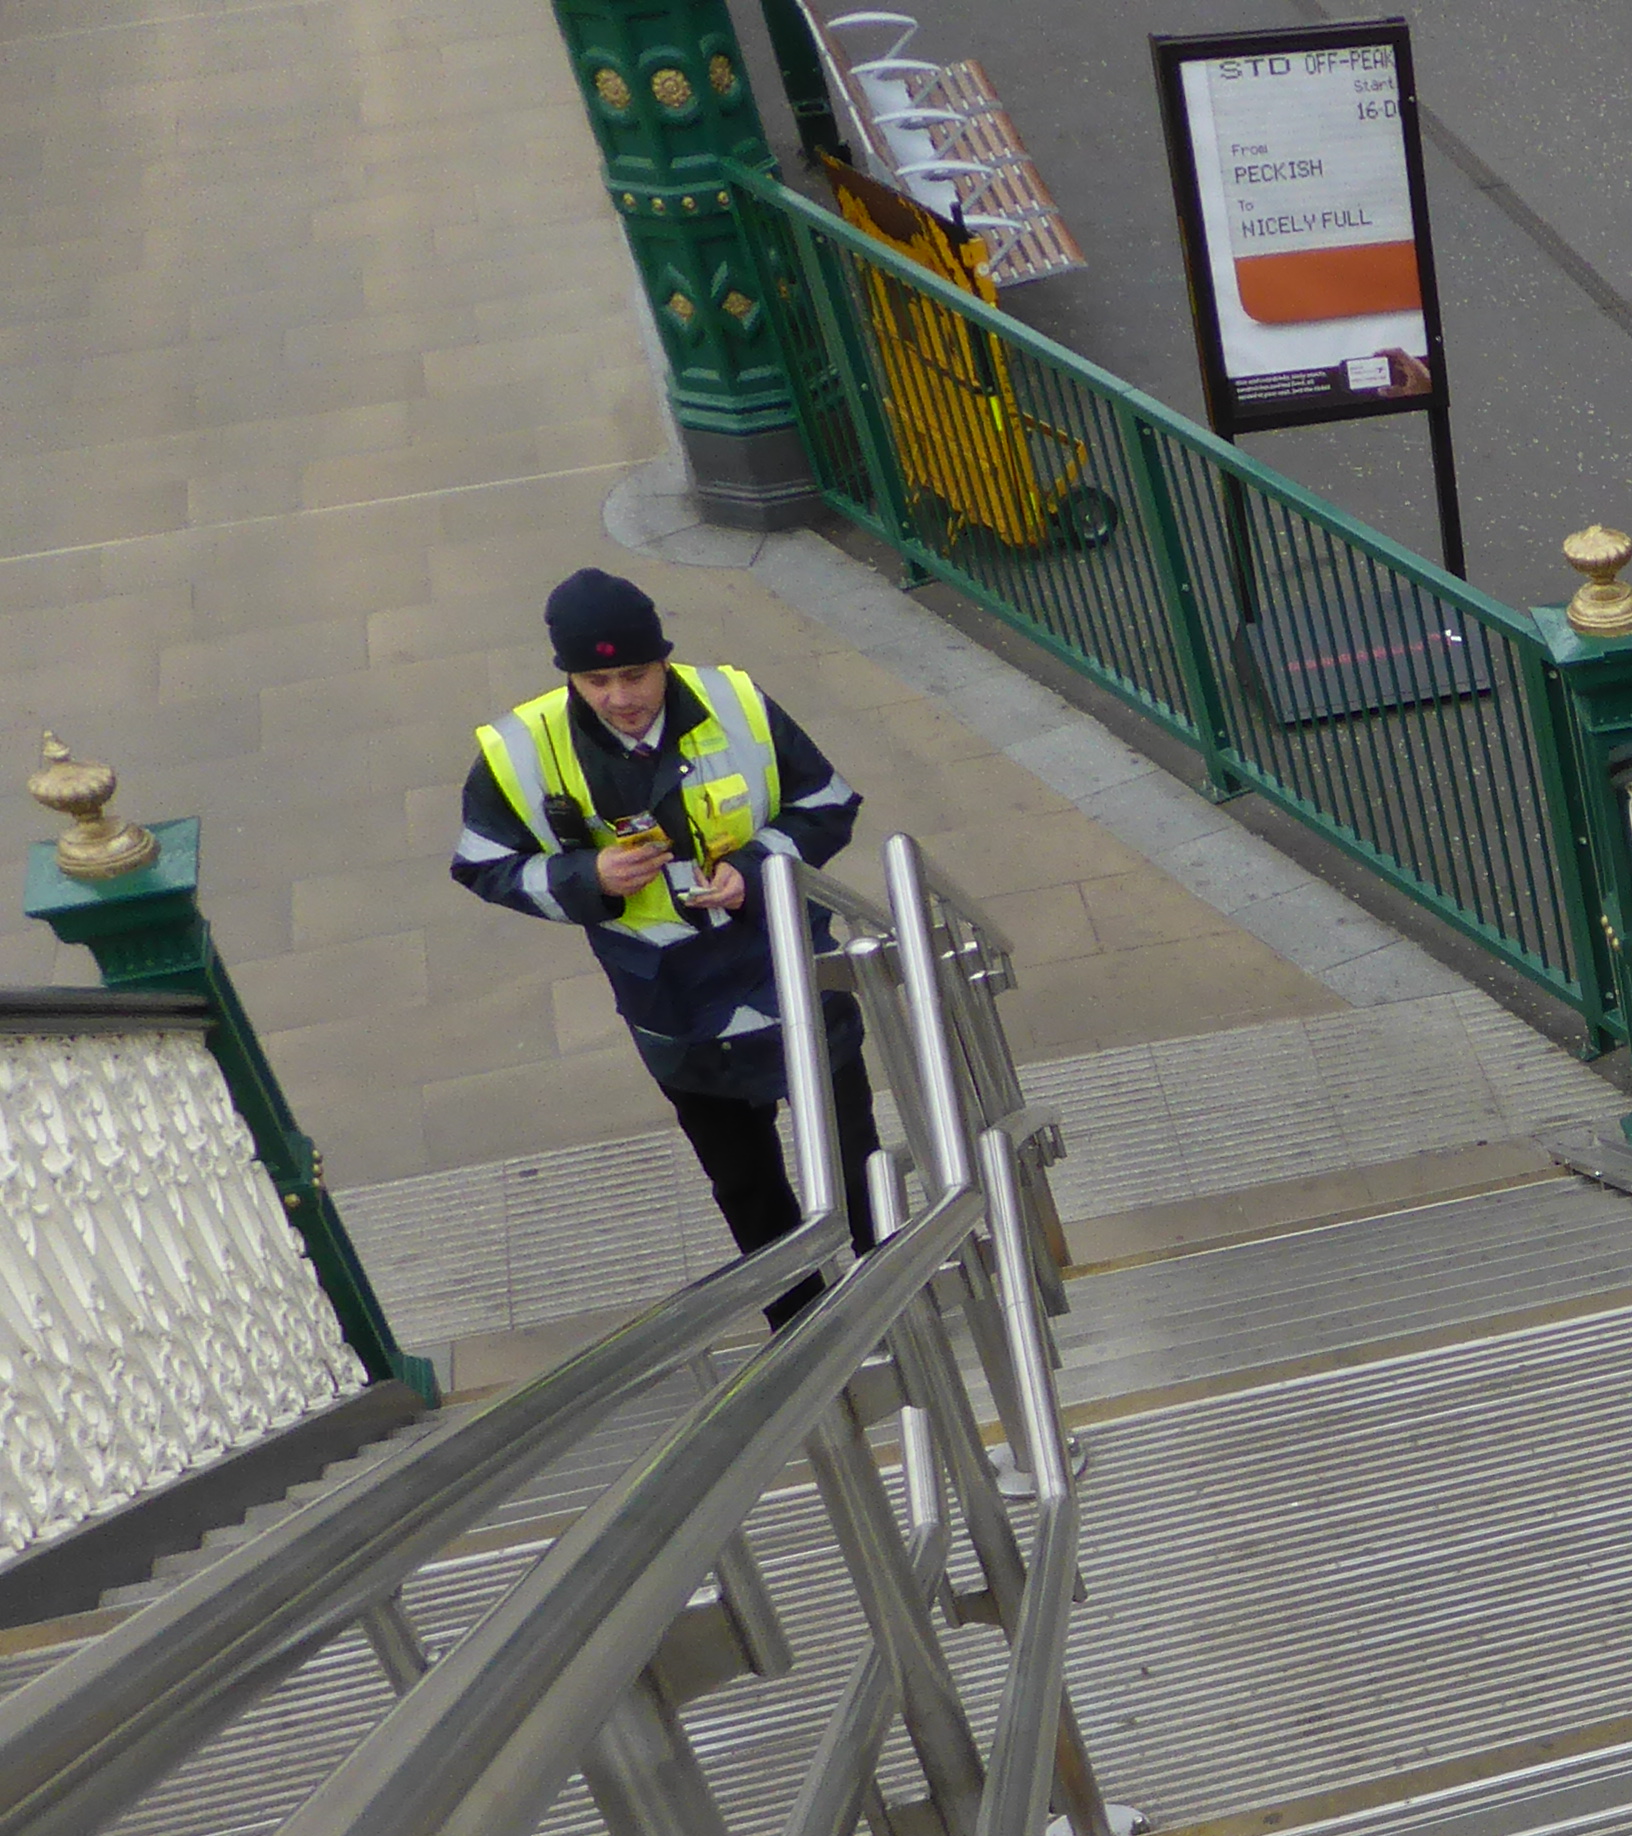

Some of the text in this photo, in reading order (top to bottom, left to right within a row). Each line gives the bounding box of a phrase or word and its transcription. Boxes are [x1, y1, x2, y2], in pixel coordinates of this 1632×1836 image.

[1219, 56, 1291, 80] STD
[1353, 77, 1395, 94] Start
[1356, 100, 1400, 121] 16-D
[1231, 143, 1269, 157] From
[1234, 159, 1323, 184] PECKISH
[1237, 200, 1254, 212] To
[1241, 209, 1373, 239] NICELY FULL
